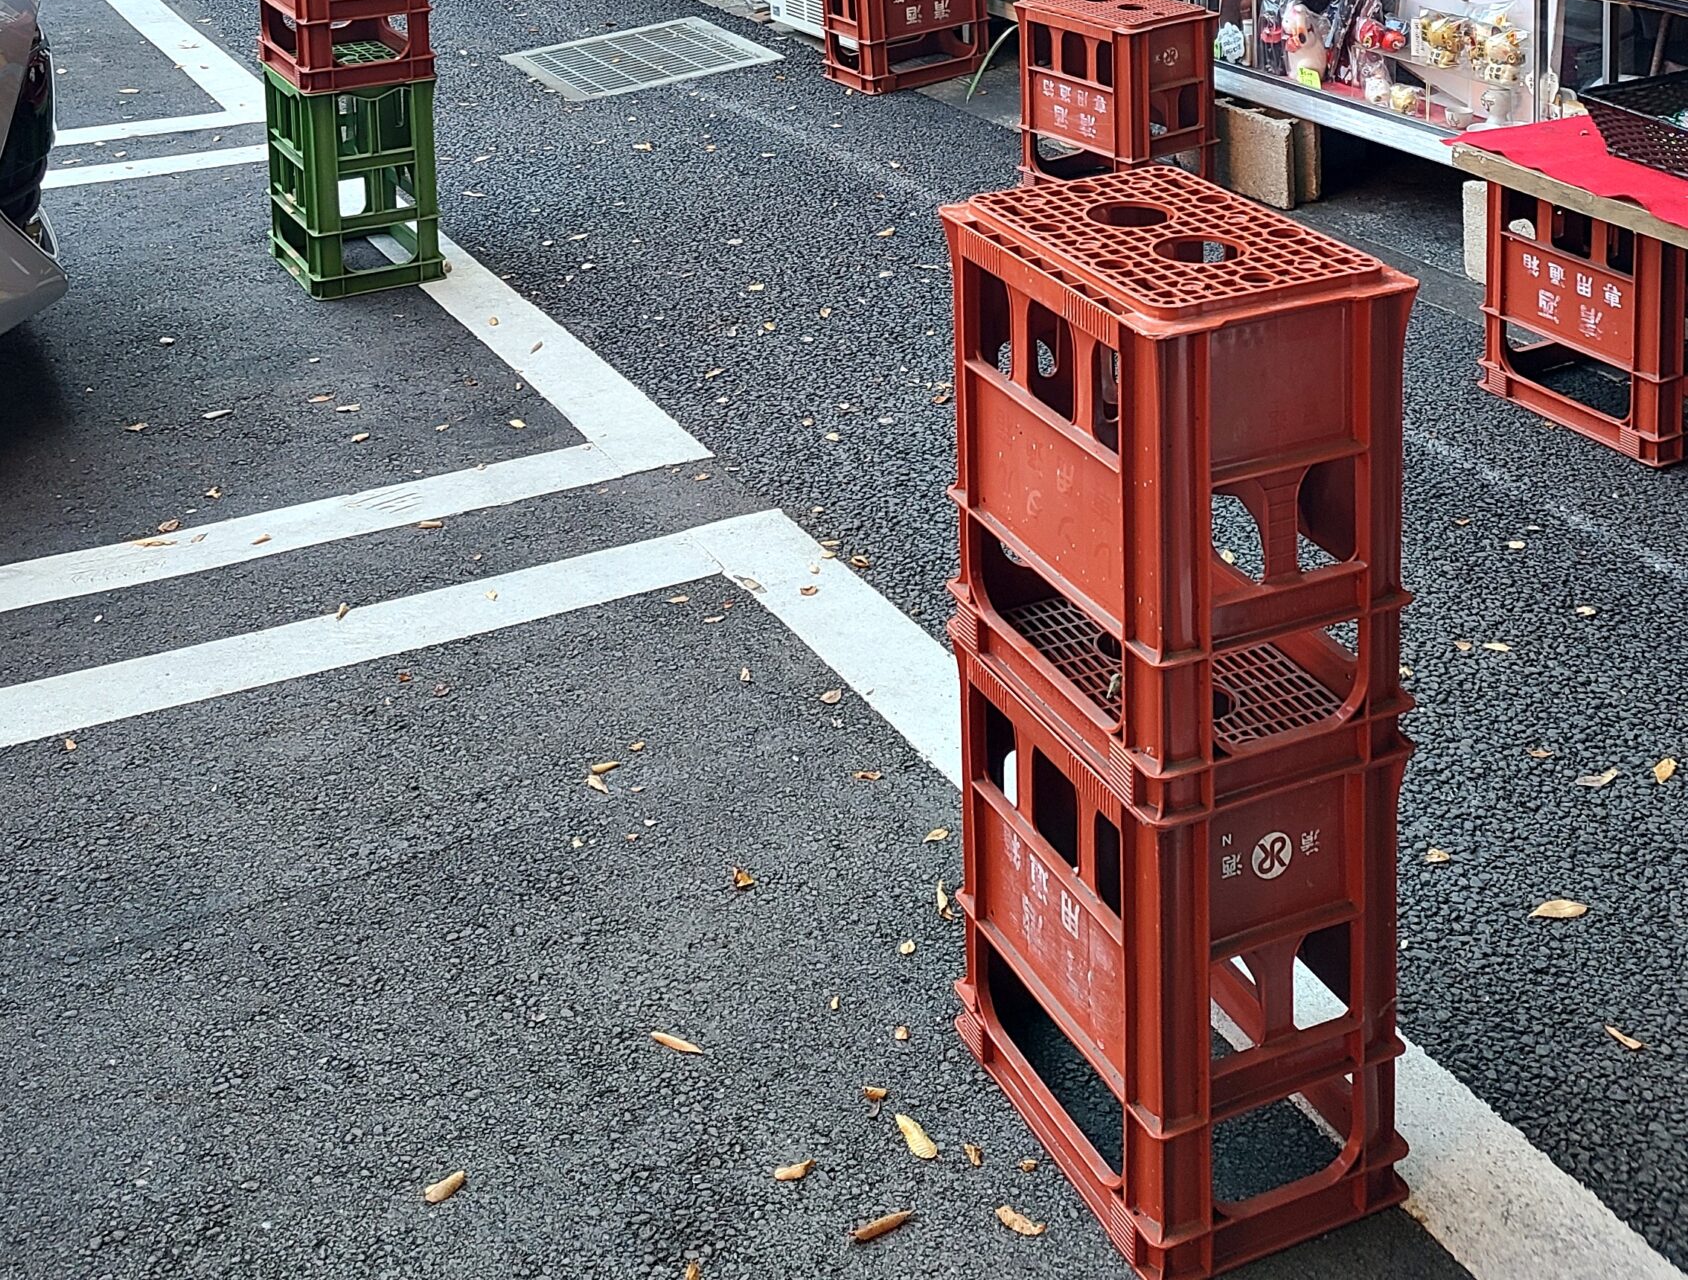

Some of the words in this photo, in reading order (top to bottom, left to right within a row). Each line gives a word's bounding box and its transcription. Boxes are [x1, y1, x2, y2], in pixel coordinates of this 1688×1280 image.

[905, 0, 951, 26] 清酒
[1053, 104, 1097, 139] 清酒
[1522, 253, 1623, 309] 専用通箱
[1537, 289, 1603, 341] 清酒
